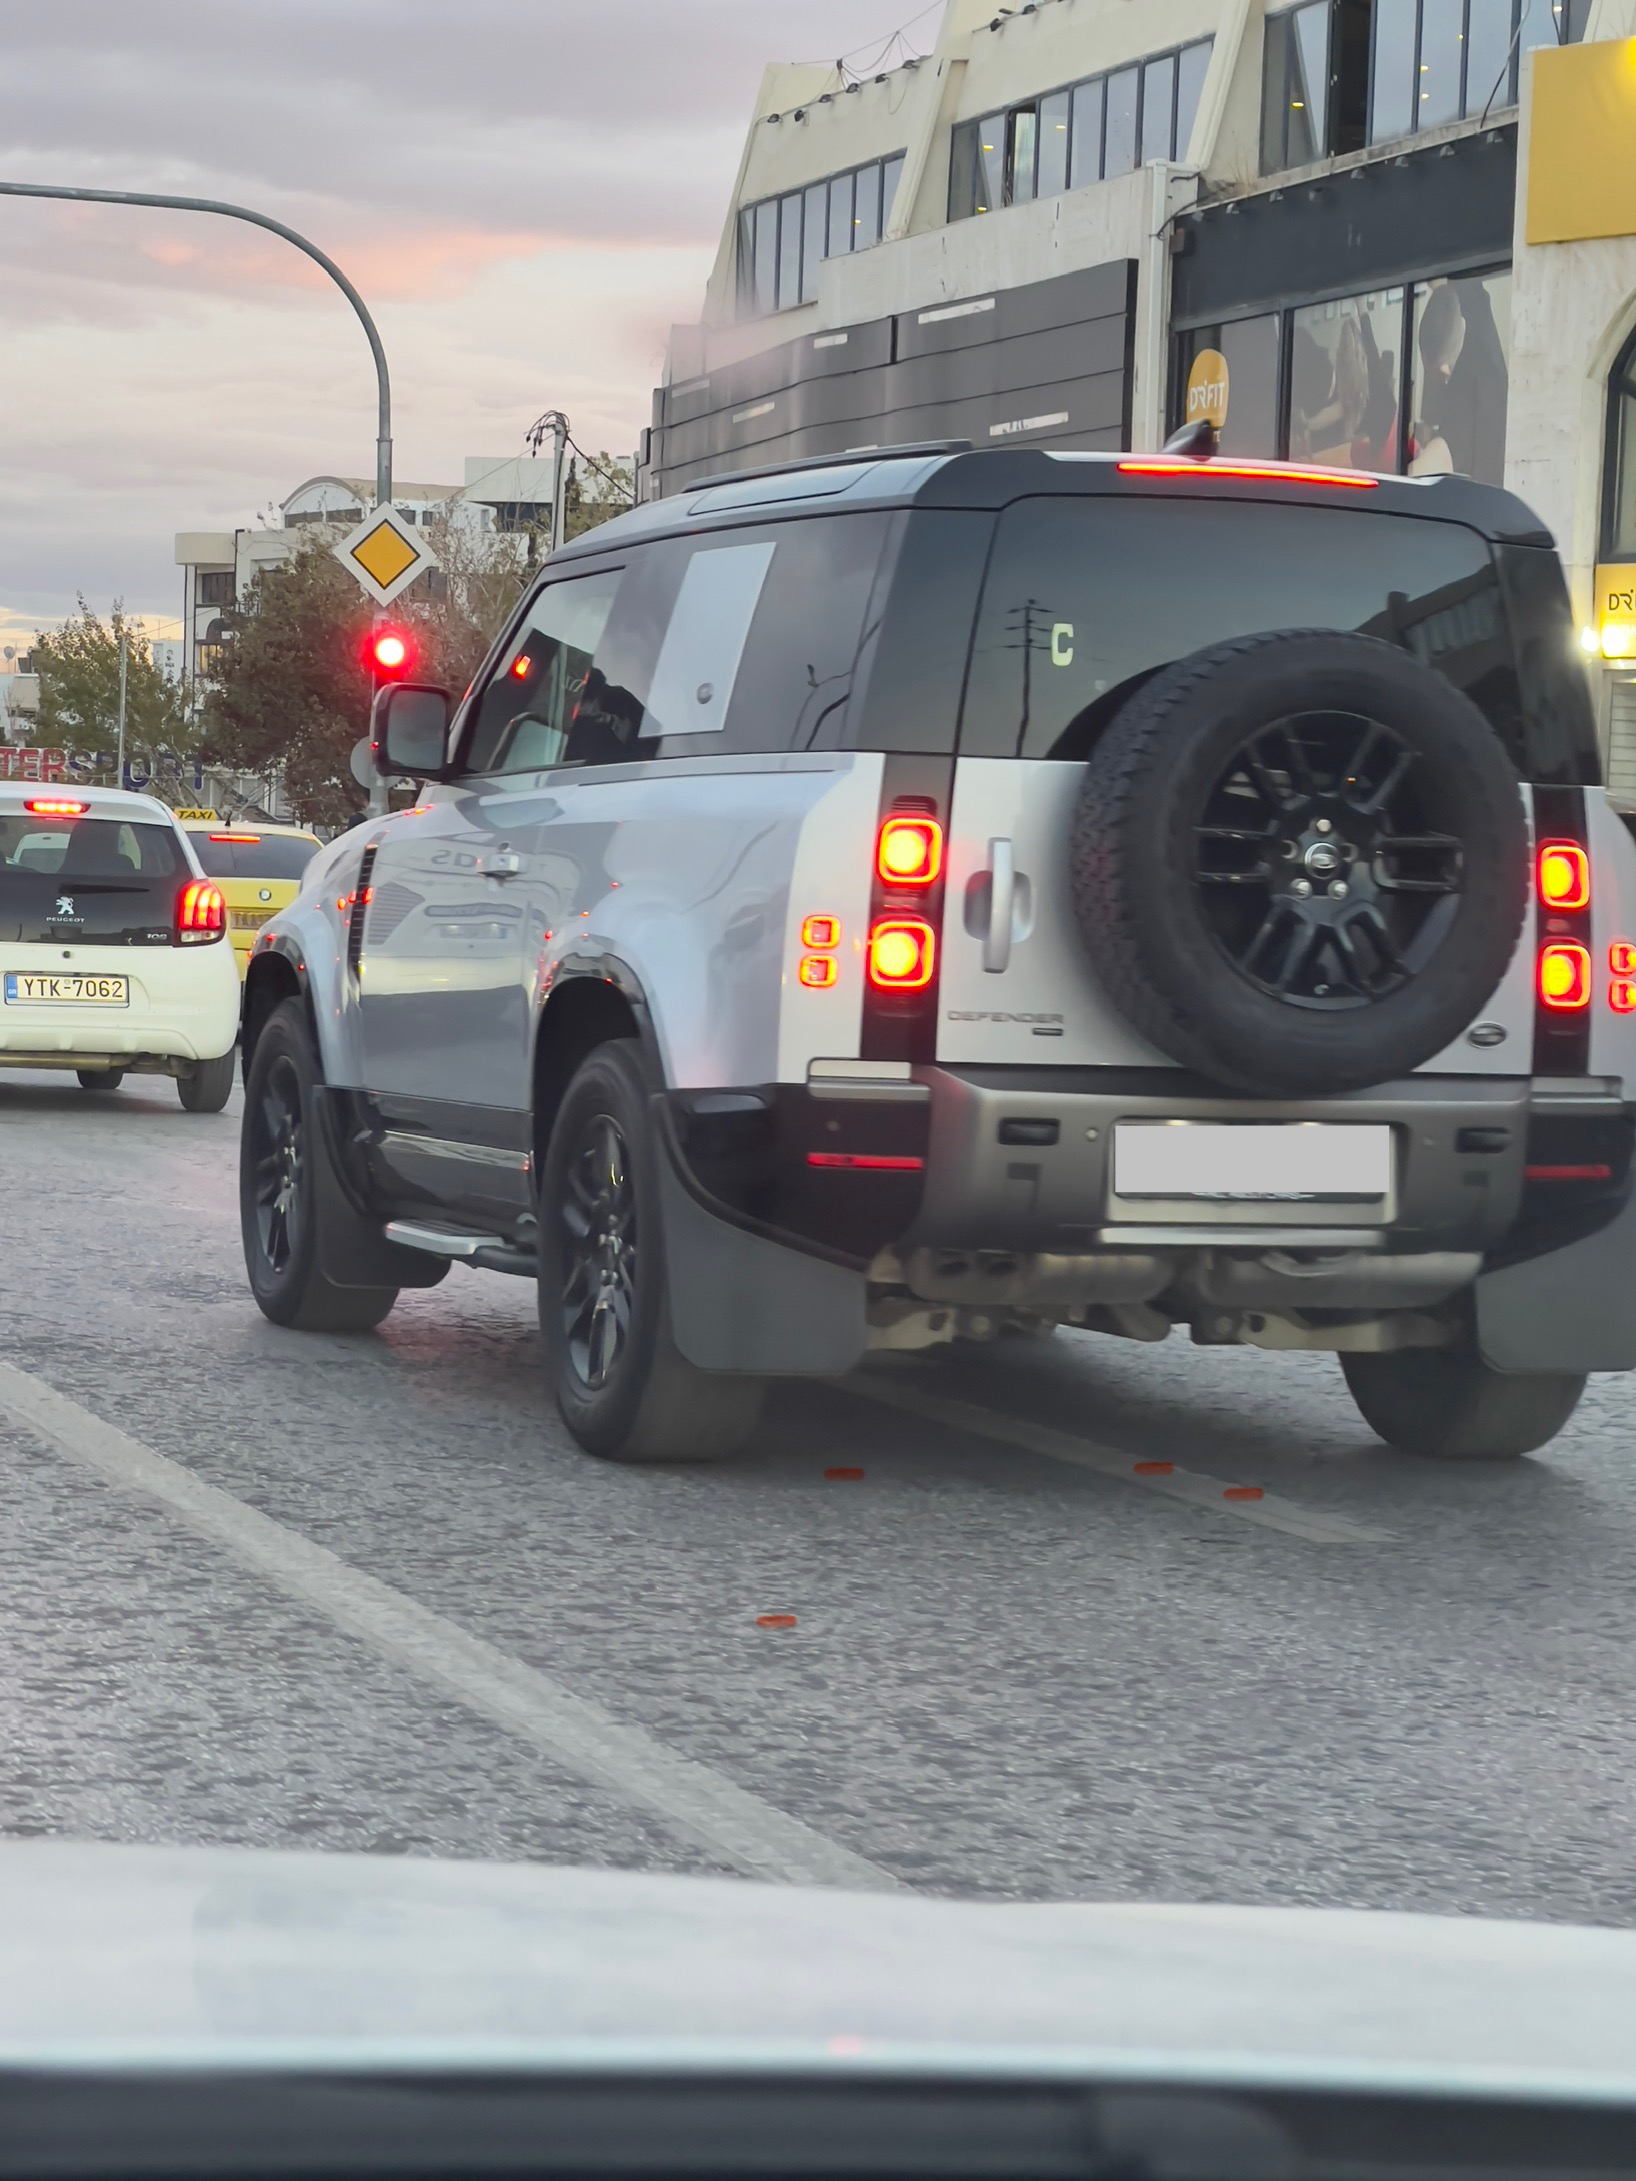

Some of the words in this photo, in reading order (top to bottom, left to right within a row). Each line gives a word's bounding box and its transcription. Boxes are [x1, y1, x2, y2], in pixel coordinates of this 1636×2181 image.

[1051, 623, 1074, 666] C
[179, 810, 213, 820] TAXI
[24, 978, 123, 998] YTK-7062
